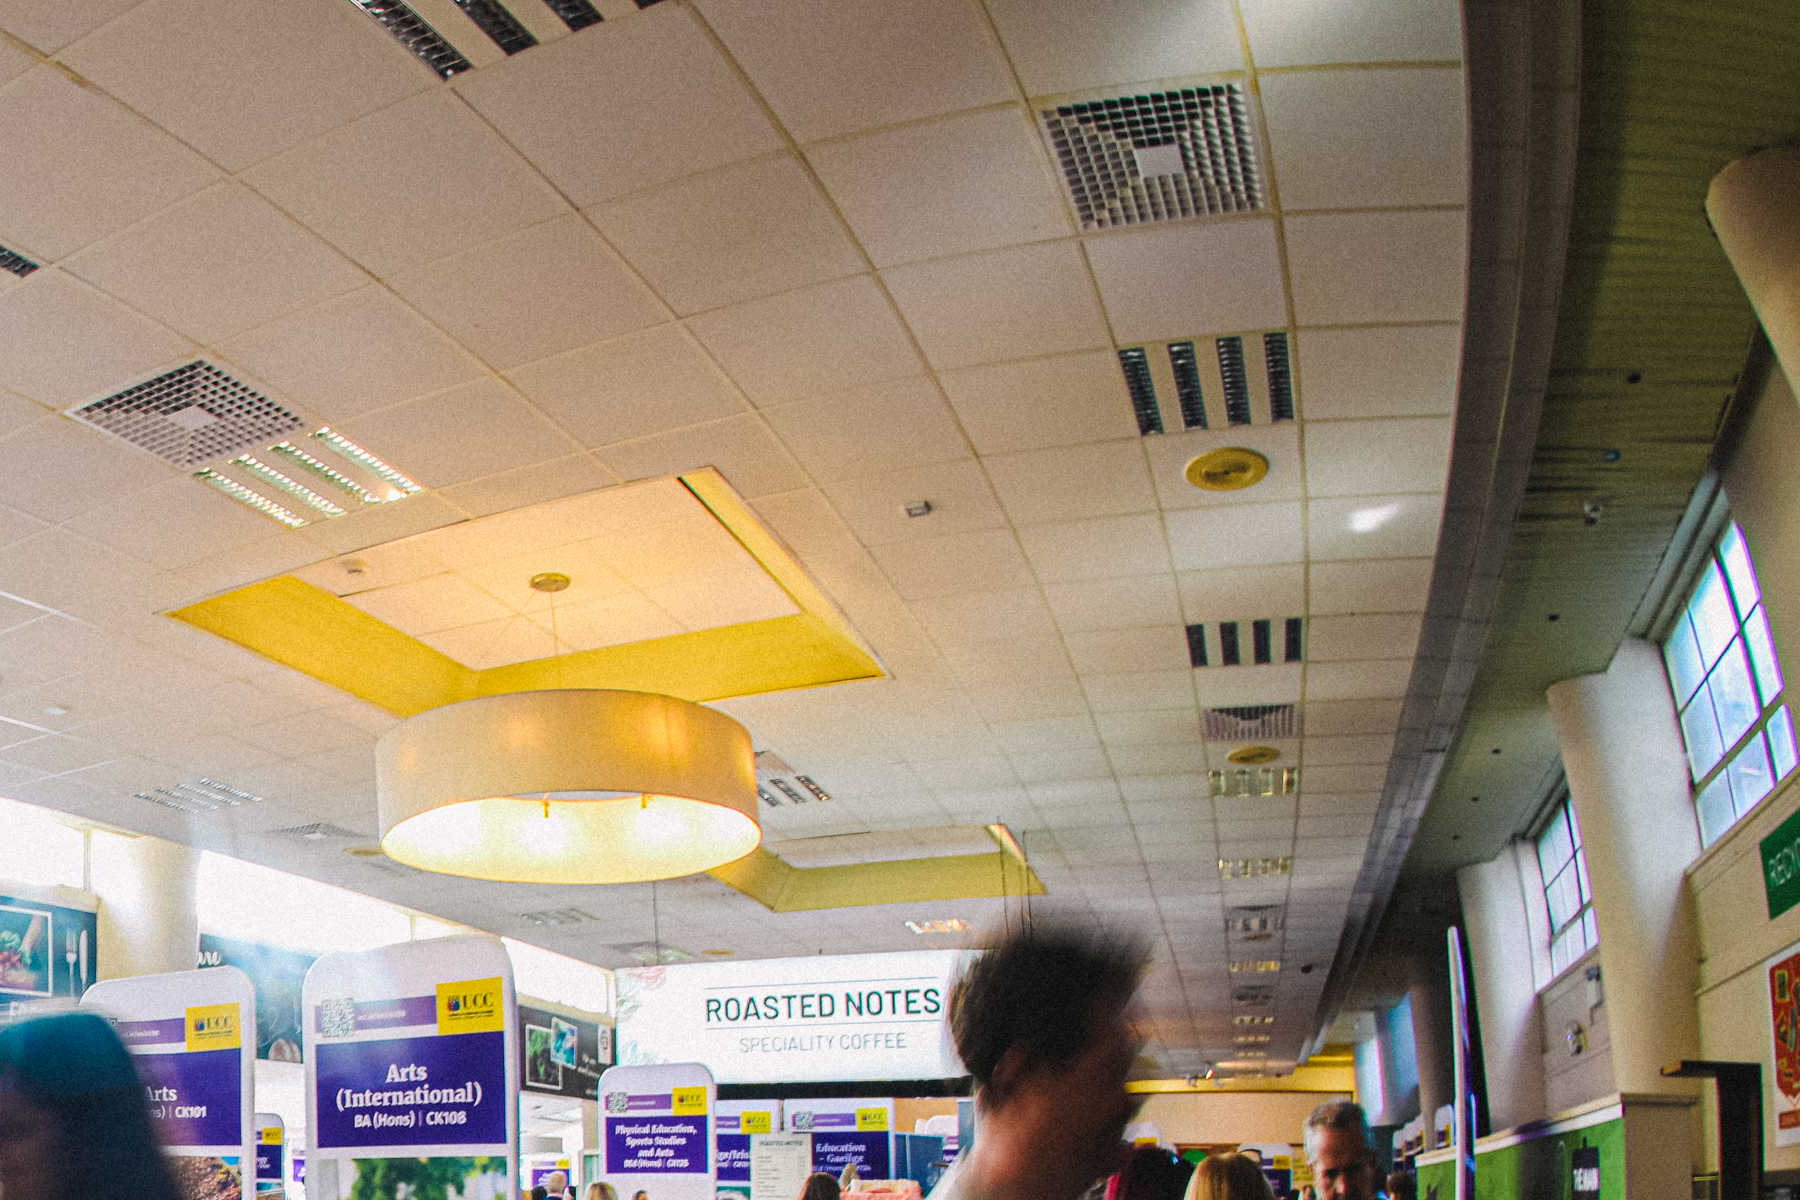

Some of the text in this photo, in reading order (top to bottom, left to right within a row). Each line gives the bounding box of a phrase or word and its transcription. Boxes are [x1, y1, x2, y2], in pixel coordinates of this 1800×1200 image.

[462, 993, 494, 1010] UCC
[706, 988, 941, 1023] ROASTED NOTES
[205, 1016, 232, 1030] UCC
[739, 1032, 907, 1053] SPECIALITY COFFEE
[385, 1063, 428, 1084] Arts
[336, 1081, 483, 1112] (International)
[175, 1106, 207, 1119] CK101
[354, 1110, 467, 1130] BA (Hons) CK108
[615, 1124, 651, 1136] Physical
[625, 1135, 687, 1149] Sports Studies
[815, 1142, 866, 1153] Education
[637, 1147, 675, 1157] and Arts
